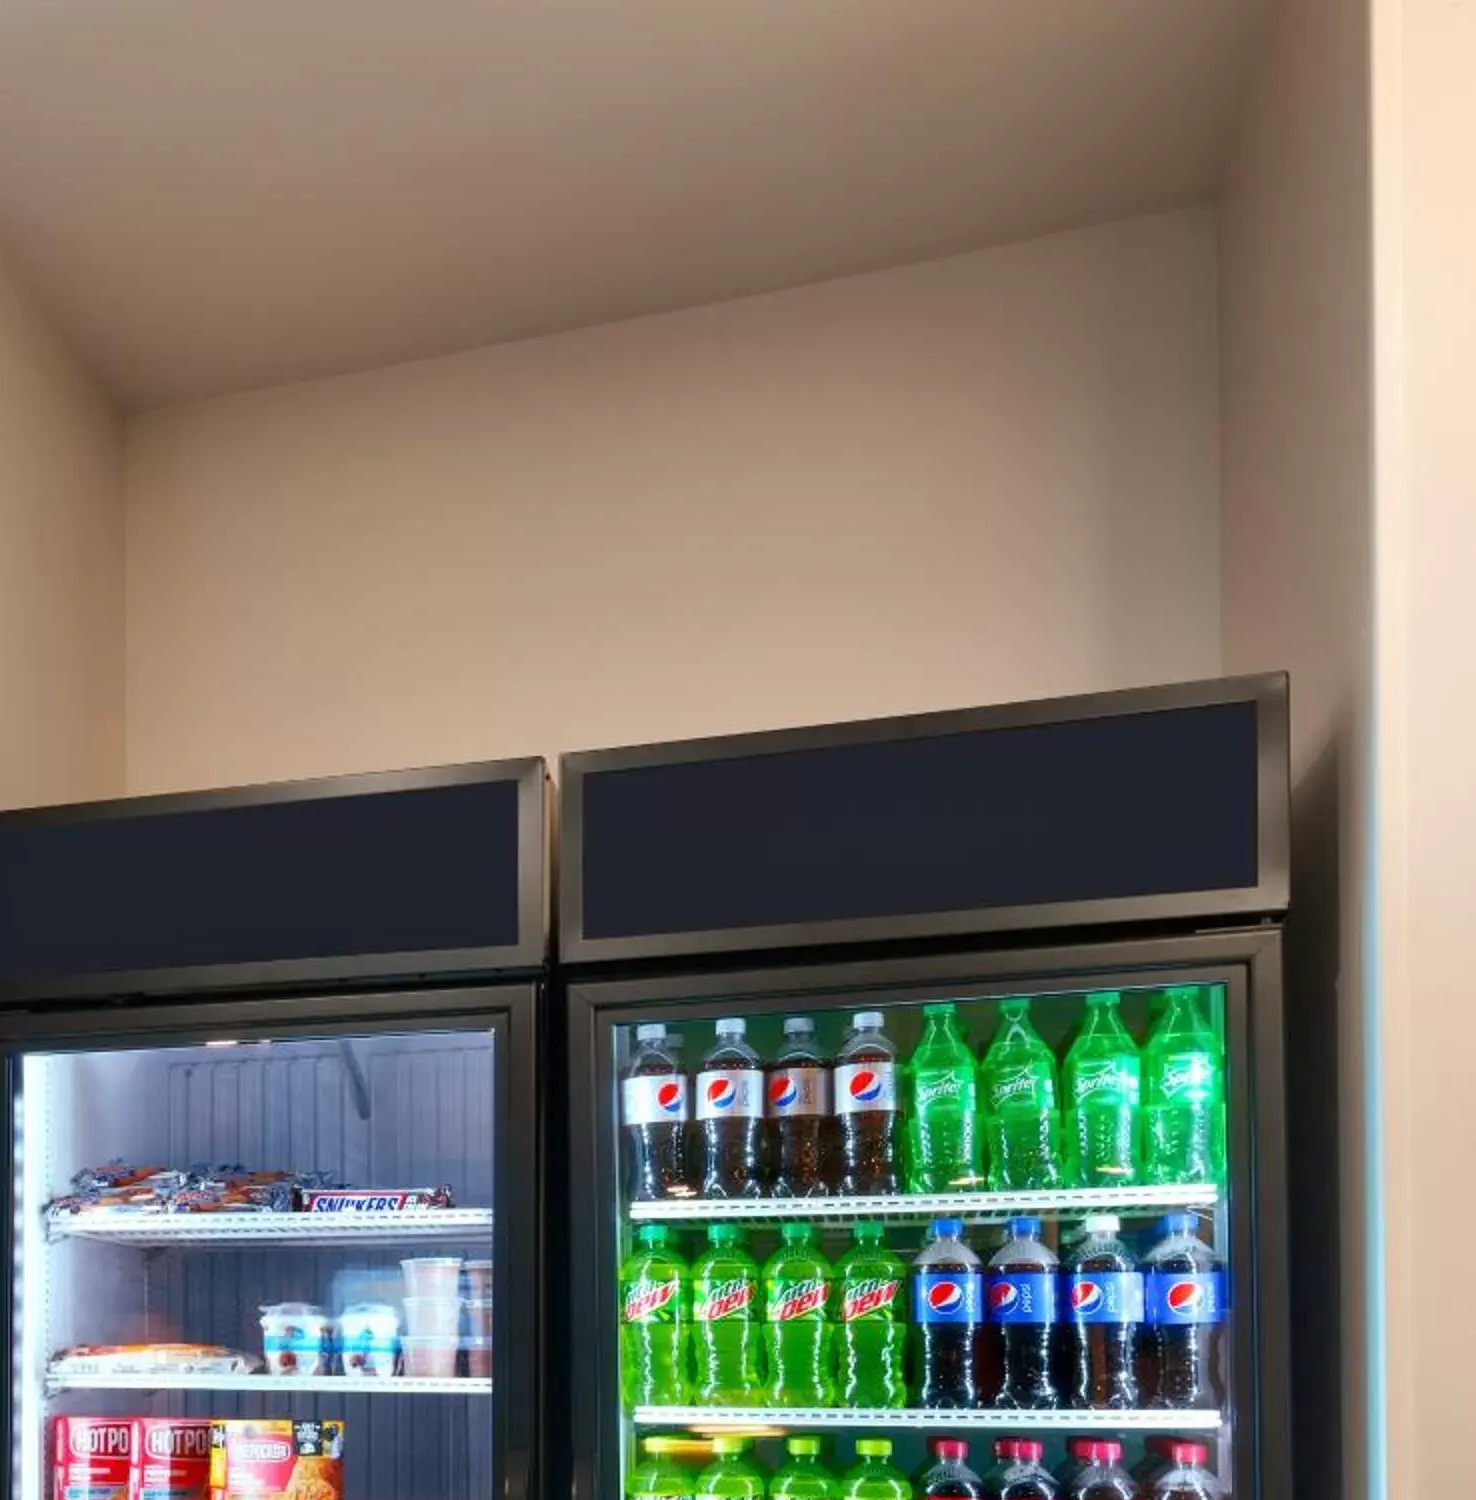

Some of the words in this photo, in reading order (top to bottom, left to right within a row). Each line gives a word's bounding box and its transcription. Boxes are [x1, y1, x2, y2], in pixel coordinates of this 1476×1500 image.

[315, 1194, 401, 1213] SNICKERS
[1020, 1283, 1033, 1314] pepsi
[1105, 1281, 1117, 1314] pepsi
